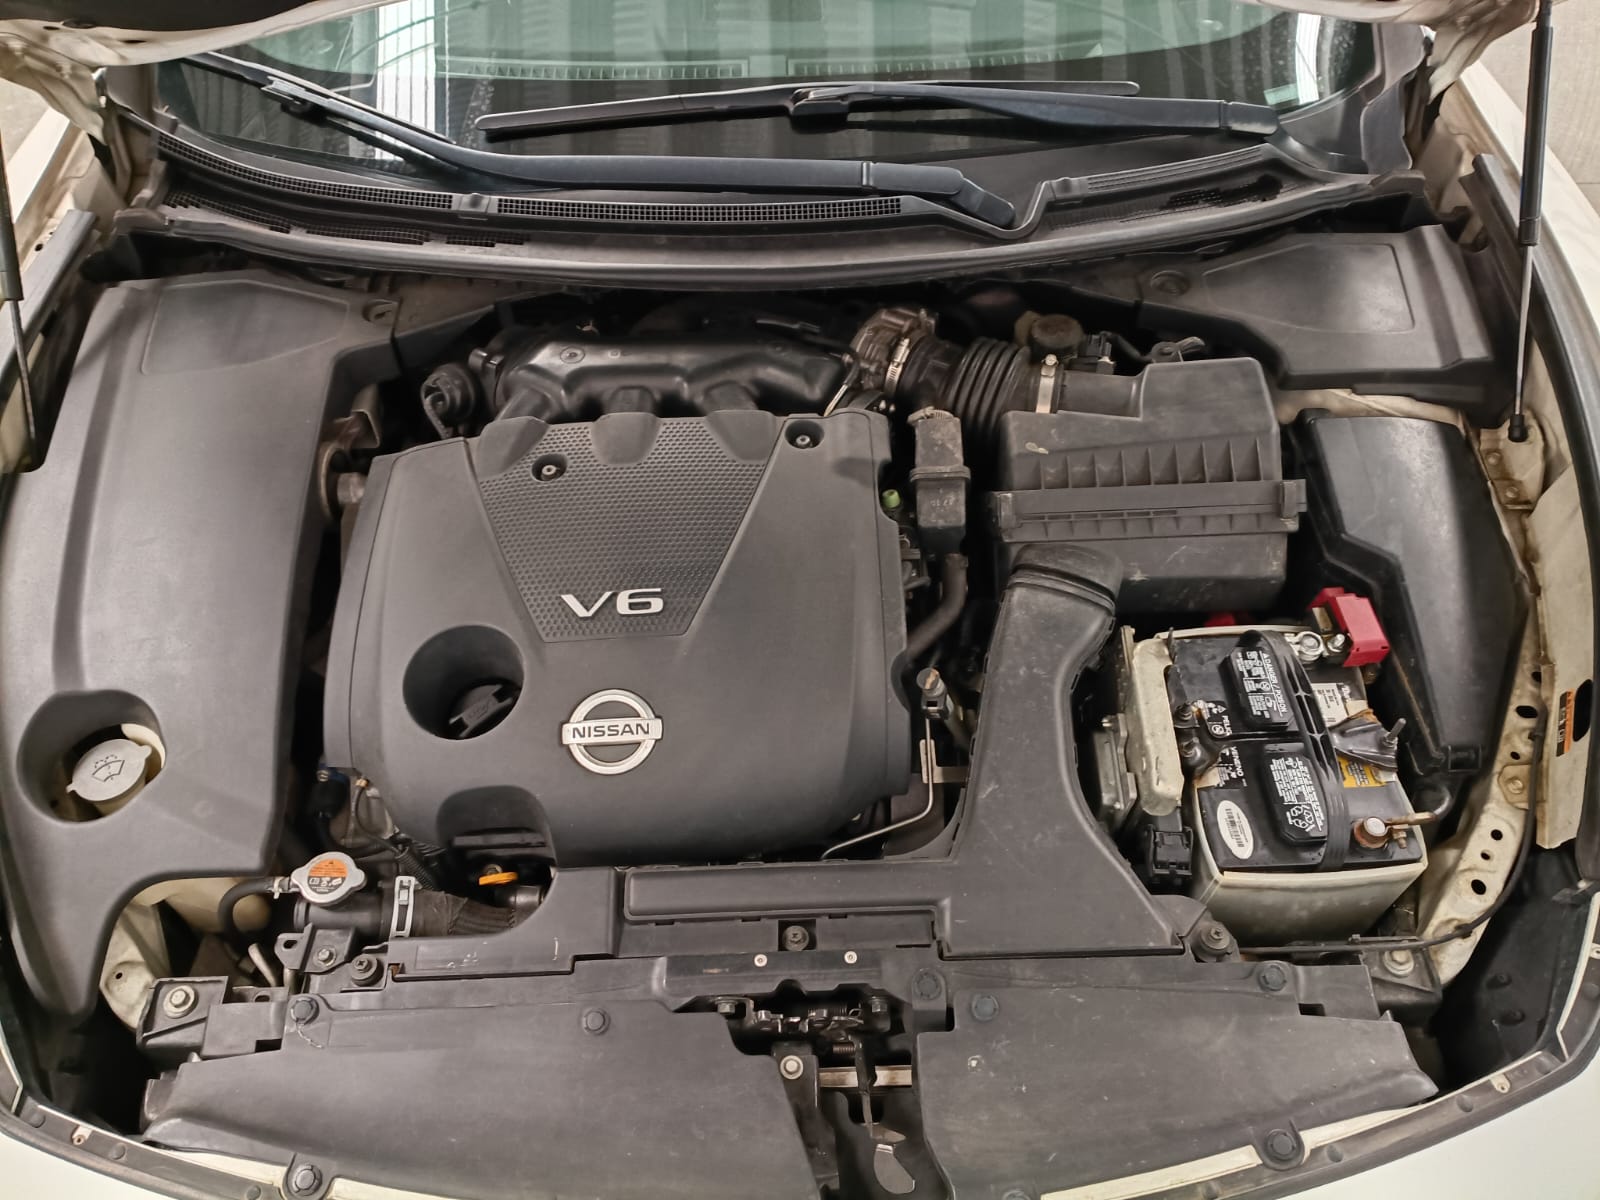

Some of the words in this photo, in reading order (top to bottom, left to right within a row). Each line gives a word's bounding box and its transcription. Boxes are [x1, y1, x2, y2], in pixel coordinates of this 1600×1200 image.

[561, 588, 664, 617] V6
[1265, 659, 1278, 684] DANGER
[1275, 689, 1288, 713] POISON
[572, 723, 650, 738] NISSAN
[1231, 746, 1244, 777] VENENO
